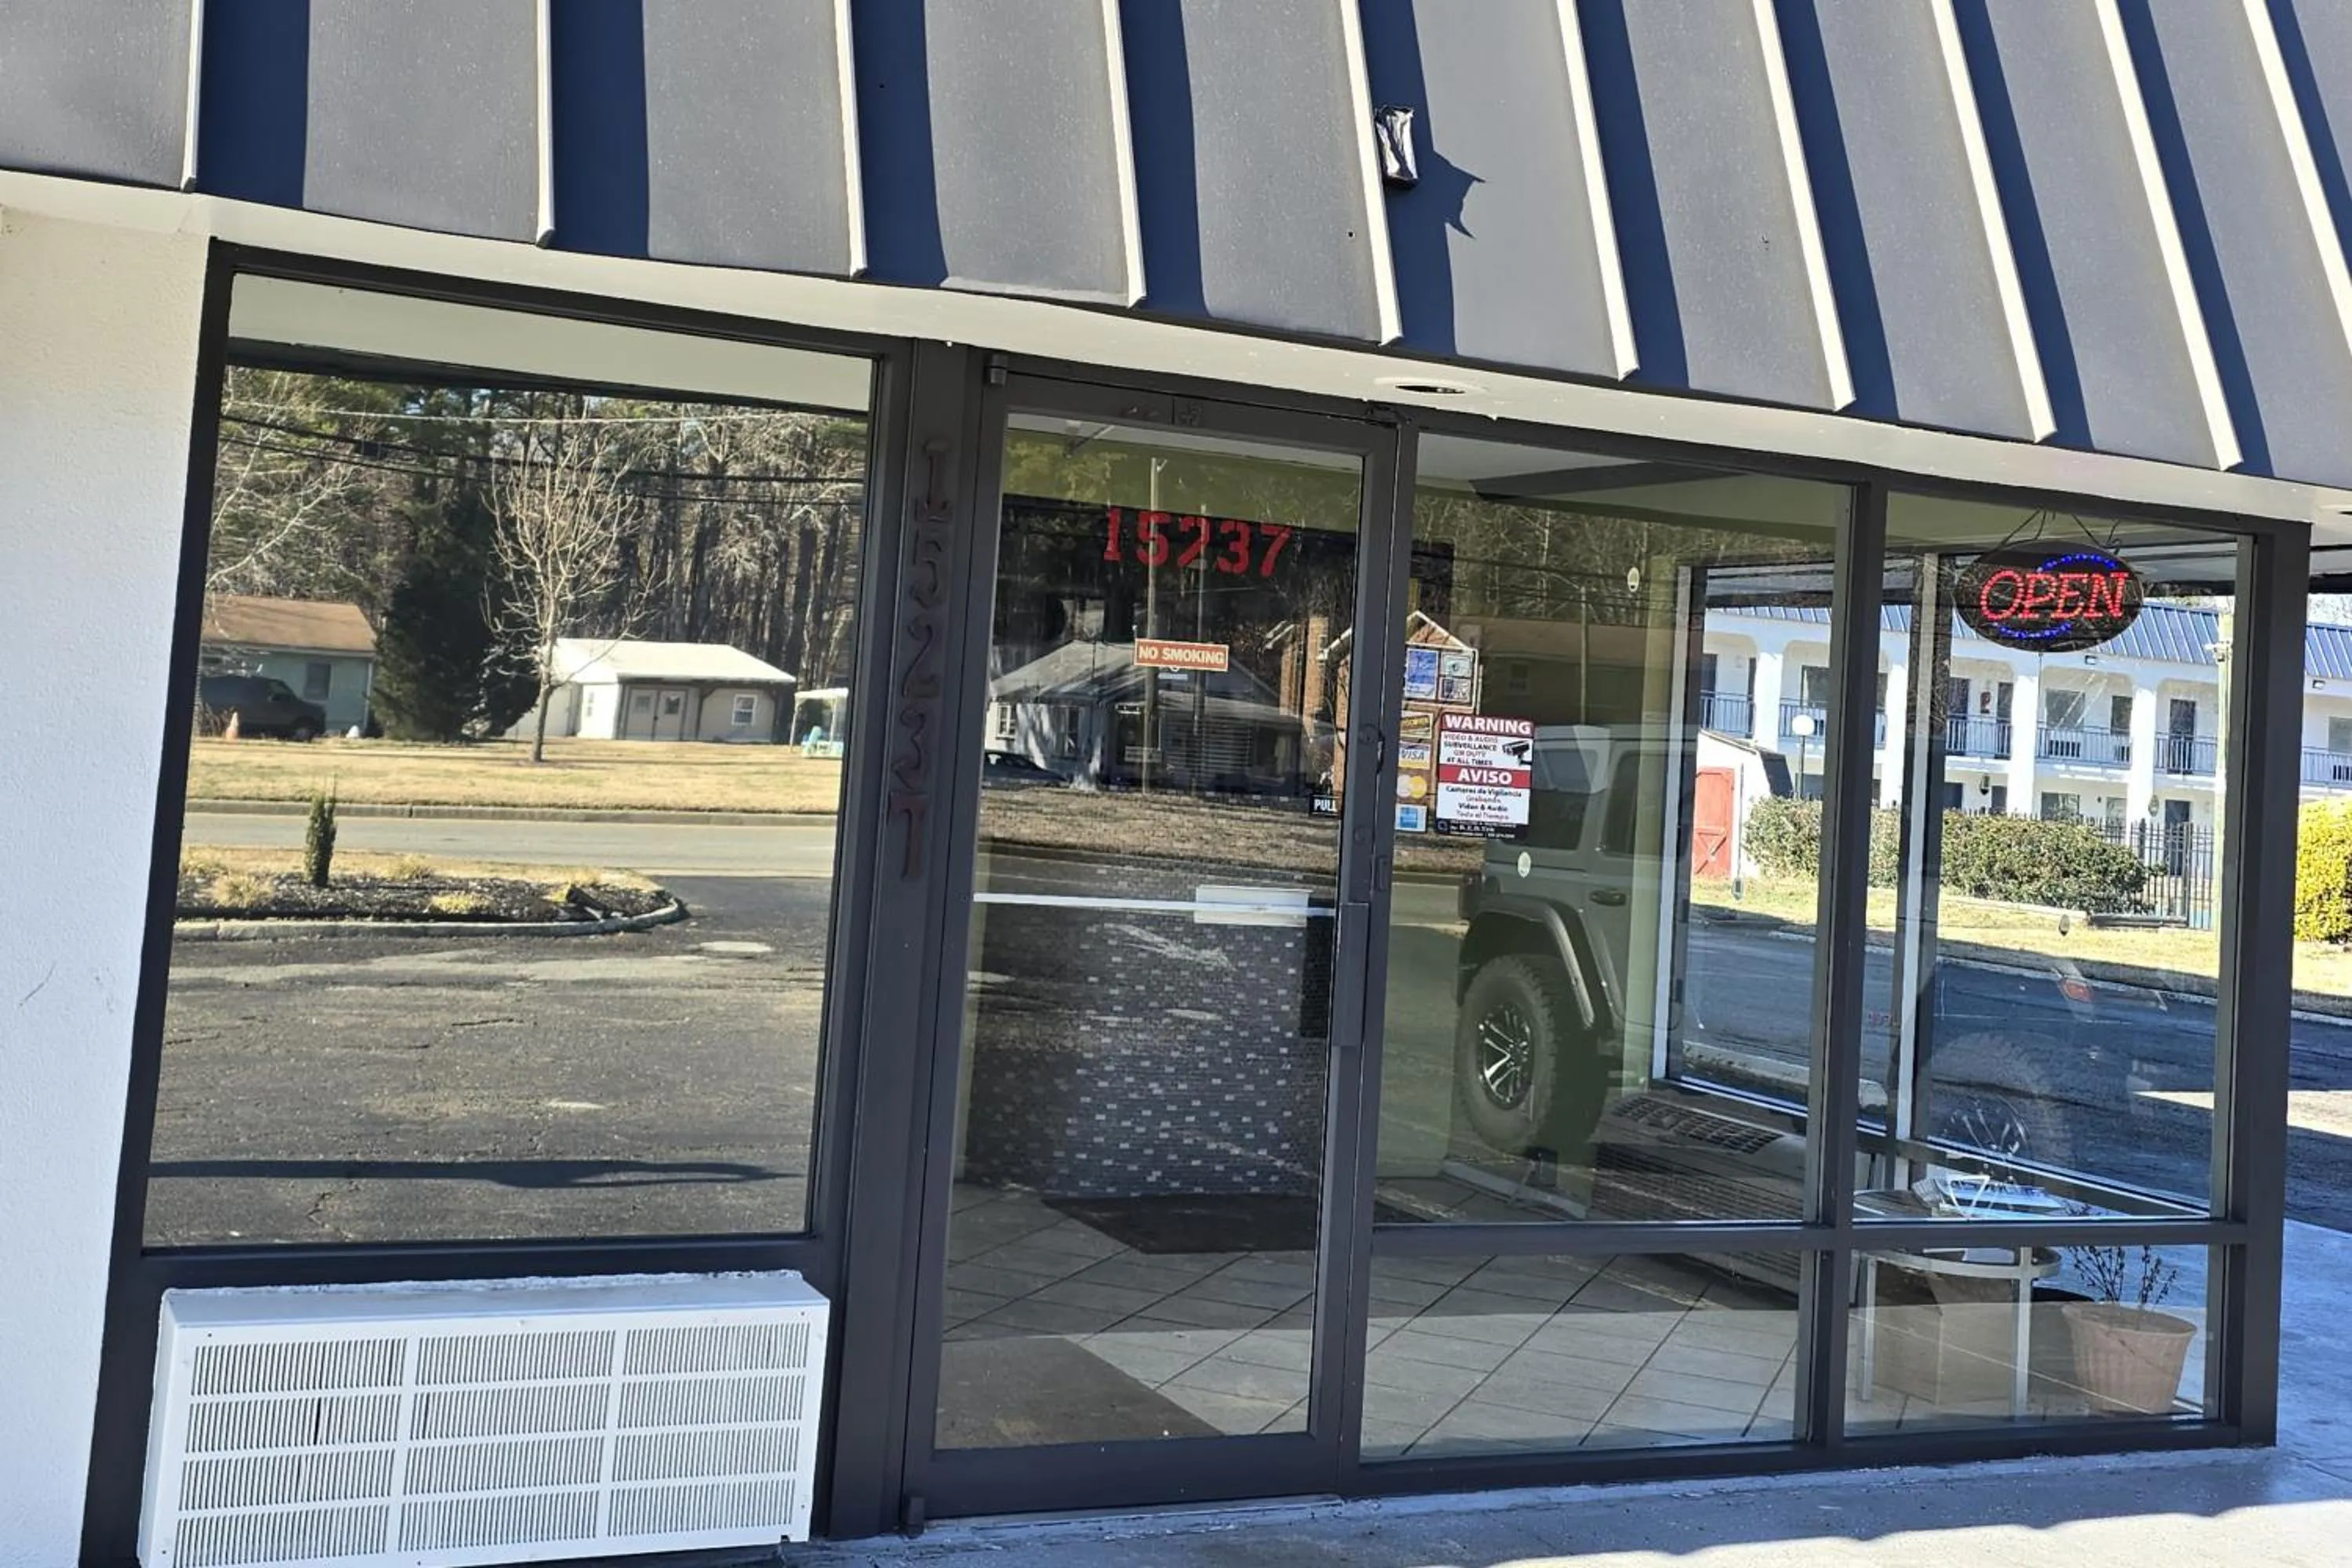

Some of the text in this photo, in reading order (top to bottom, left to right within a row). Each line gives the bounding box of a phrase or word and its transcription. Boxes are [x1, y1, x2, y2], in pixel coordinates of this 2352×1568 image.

[1103, 507, 1294, 578] 15237
[1979, 568, 2129, 621] OPEN
[1138, 645, 1225, 664] NO SMOKING
[1444, 714, 1531, 735] WARNING
[1401, 749, 1425, 760] VISA
[1458, 768, 1513, 785] AVISO
[1314, 799, 1338, 812] PULL
